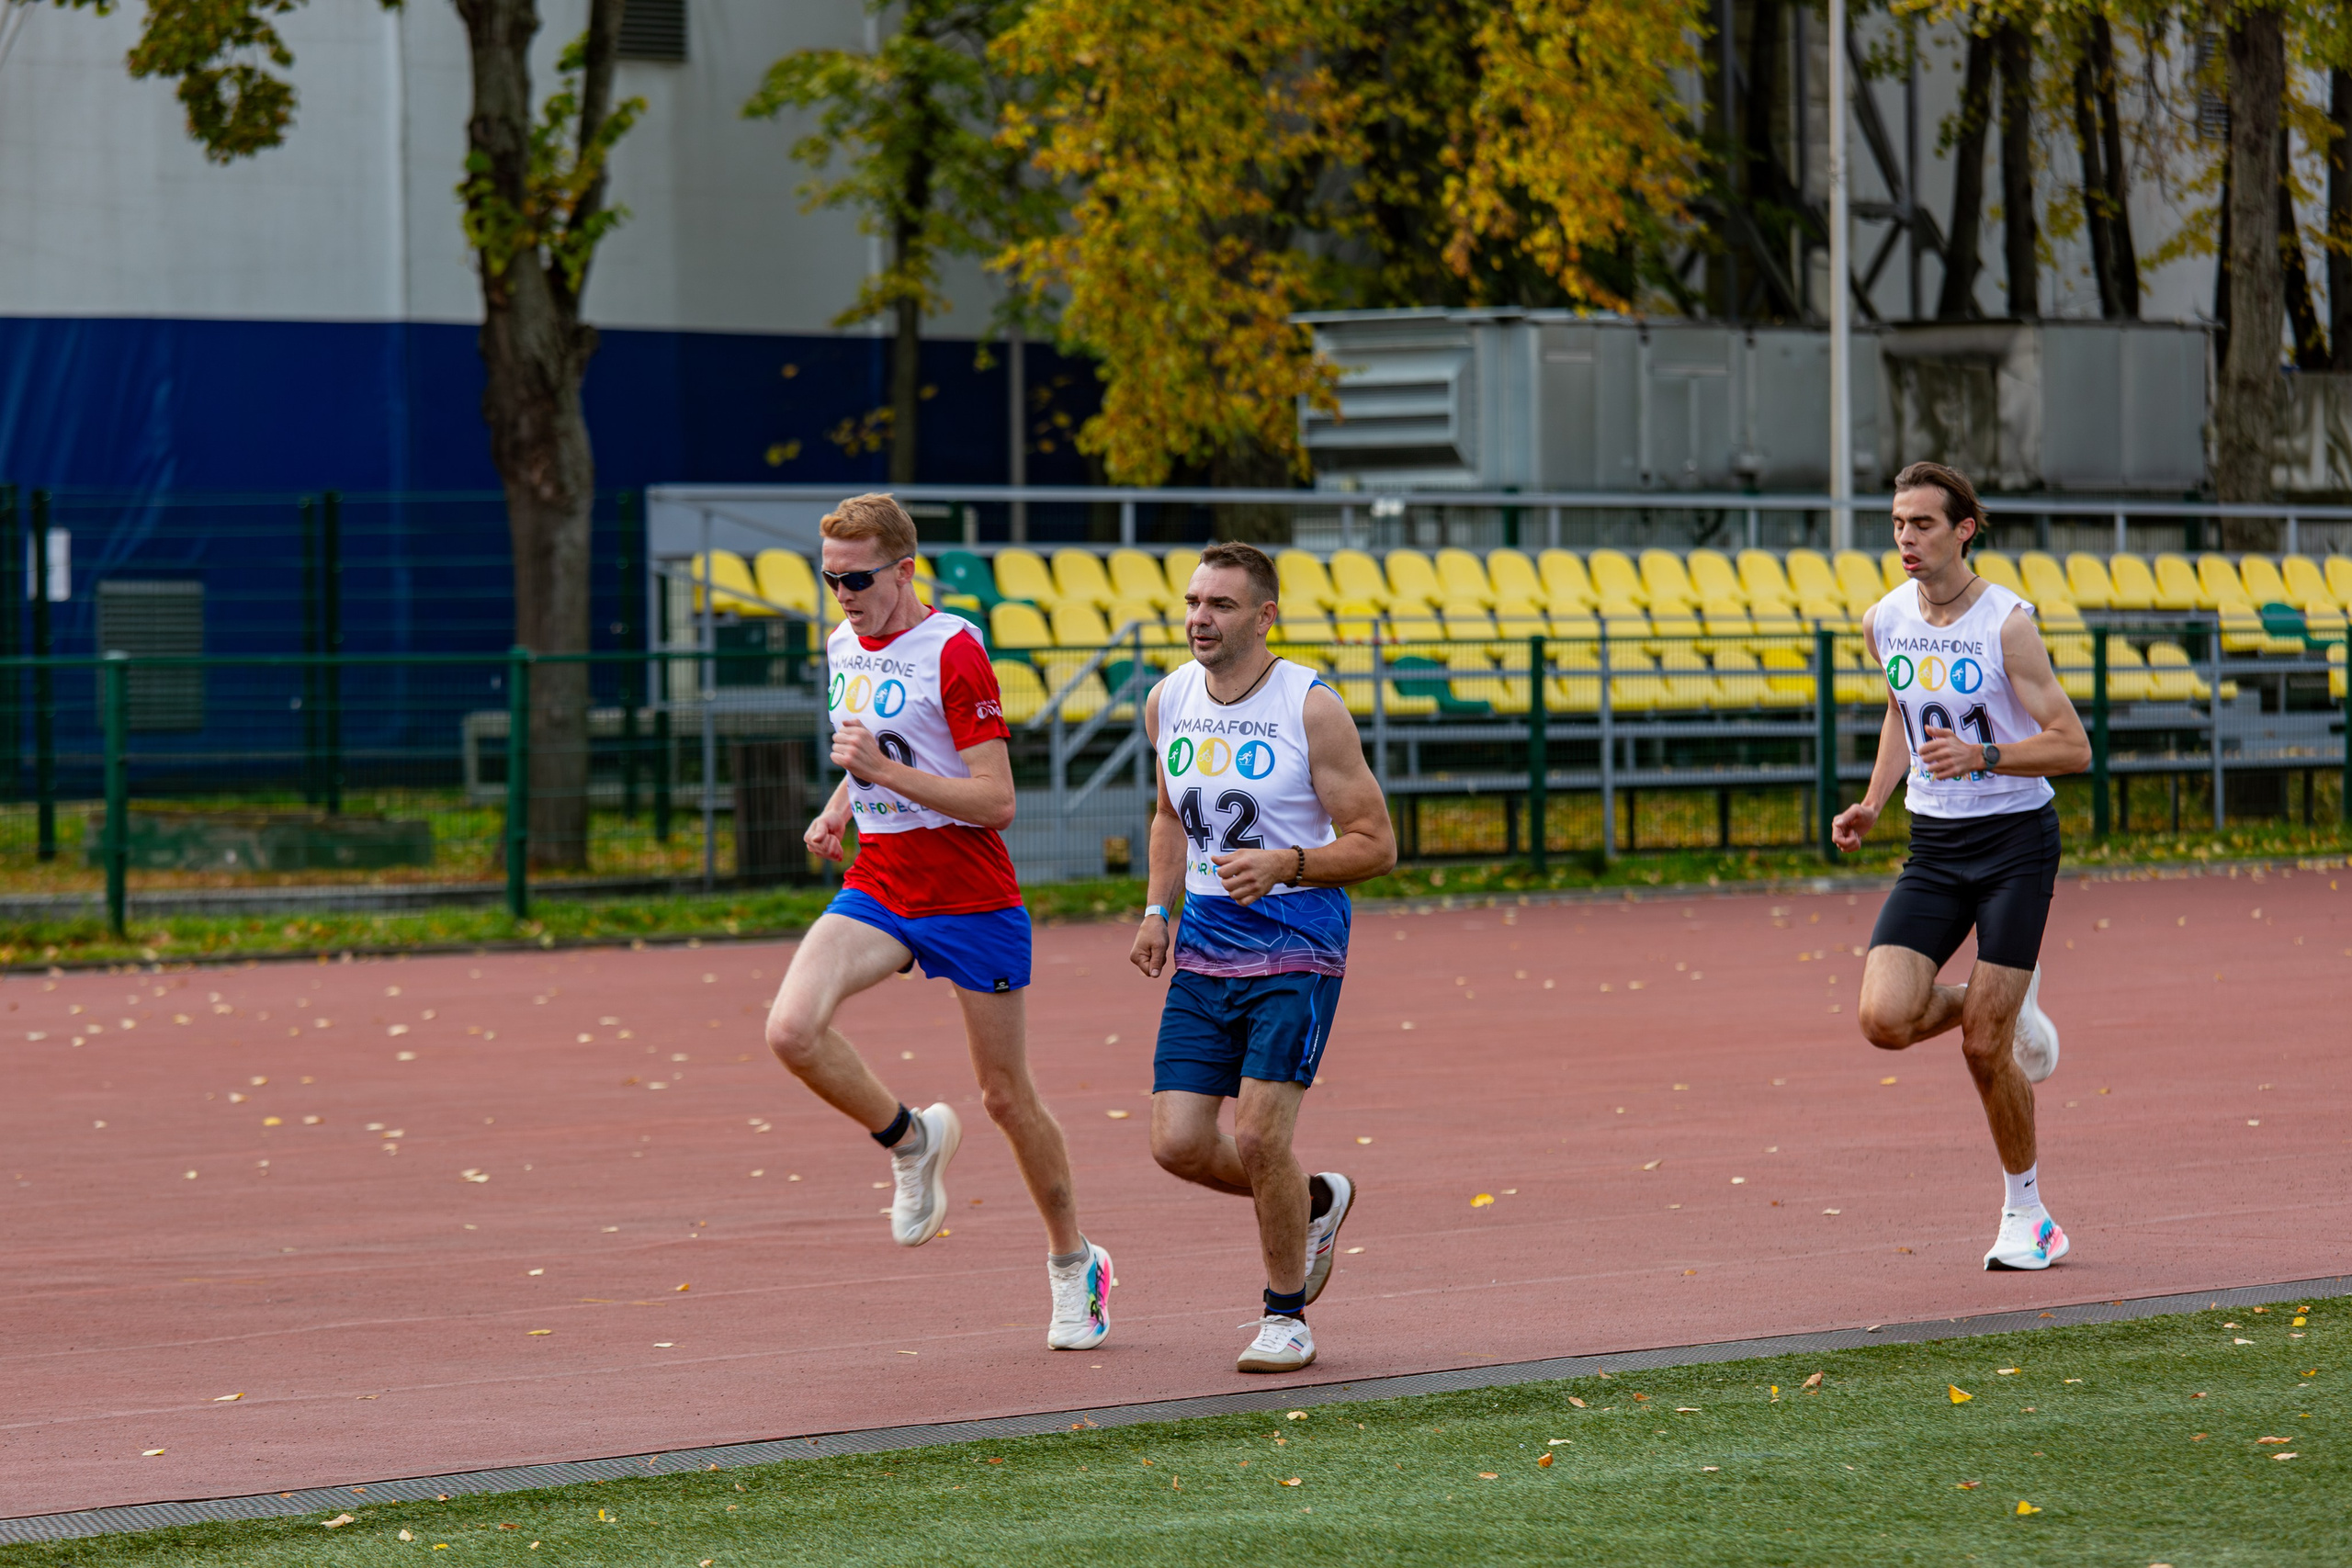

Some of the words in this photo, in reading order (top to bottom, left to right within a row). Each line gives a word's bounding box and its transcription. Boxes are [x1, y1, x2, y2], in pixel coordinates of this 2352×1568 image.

[1887, 637, 1984, 655] VMARAFONE
[1172, 717, 1279, 739] VMARAFONE
[1898, 700, 1996, 757] 101
[1179, 787, 1265, 852] 42
